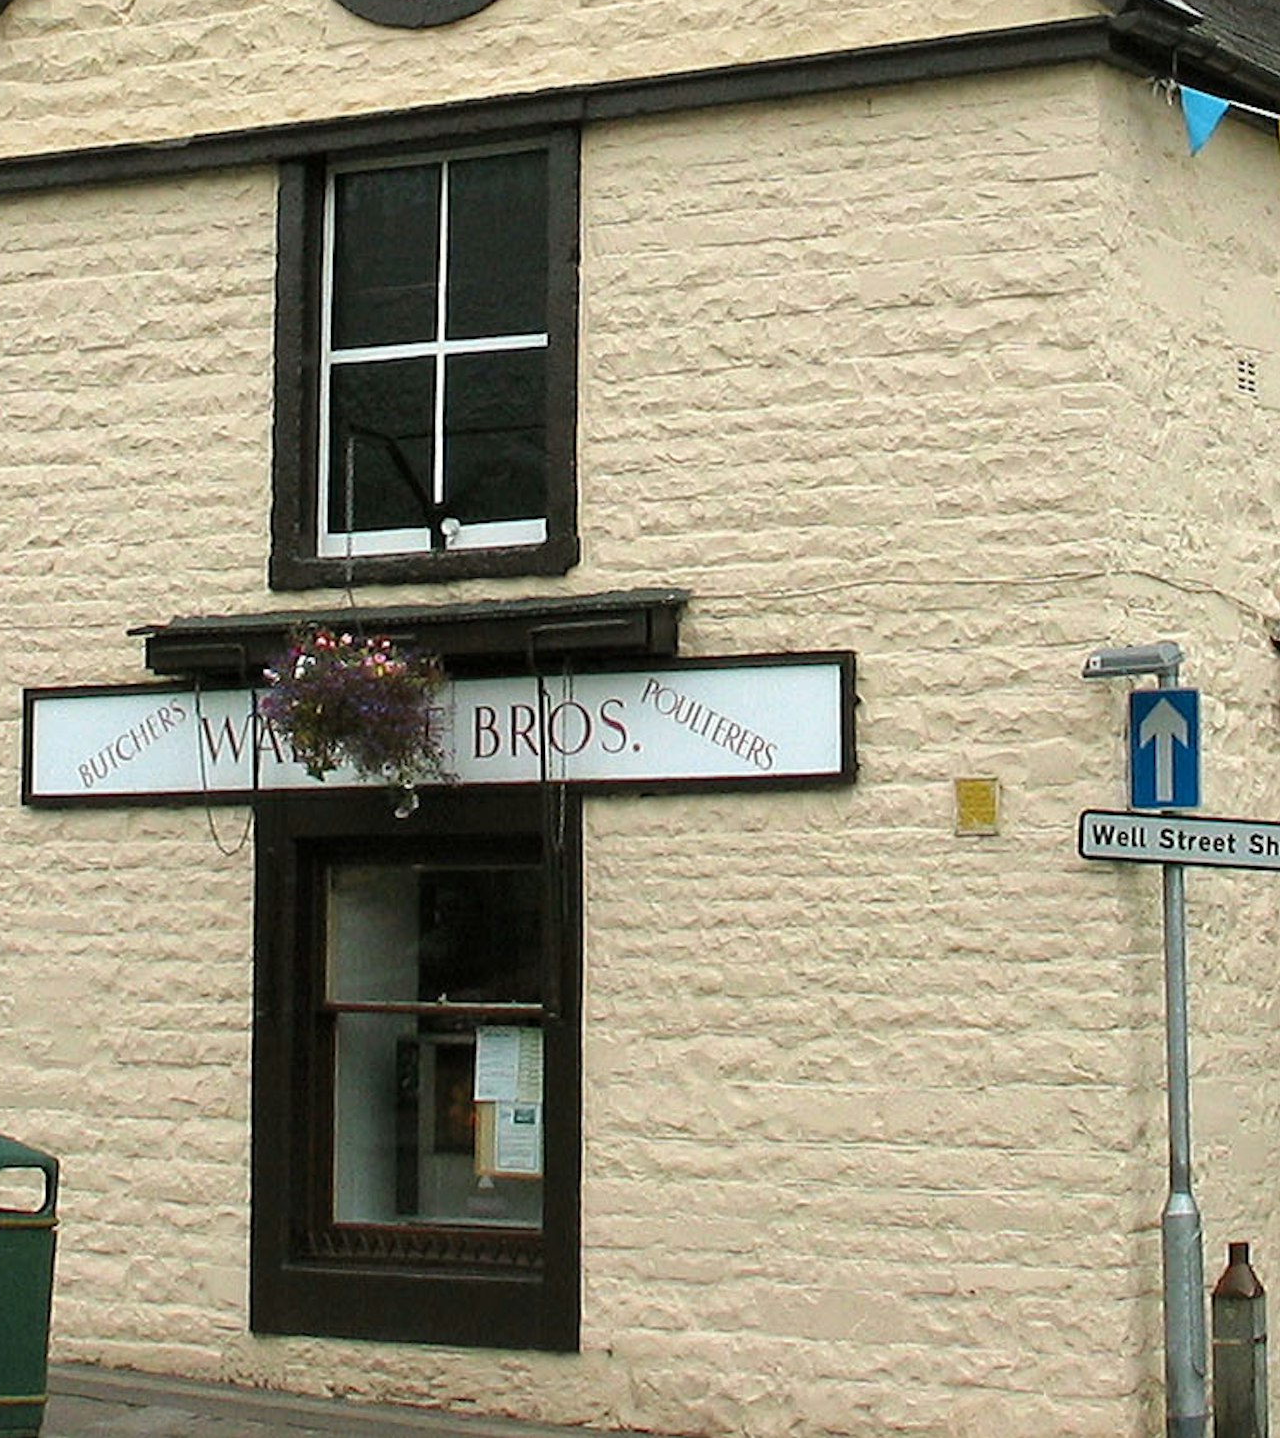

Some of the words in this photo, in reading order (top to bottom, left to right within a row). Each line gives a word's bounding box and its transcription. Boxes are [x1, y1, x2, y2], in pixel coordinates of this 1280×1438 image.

[77, 697, 188, 789] BUTCHERS
[473, 698, 642, 760] BROS.
[640, 677, 778, 771] POULTERERS
[1092, 824, 1146, 848] Well
[1158, 828, 1237, 854] Street
